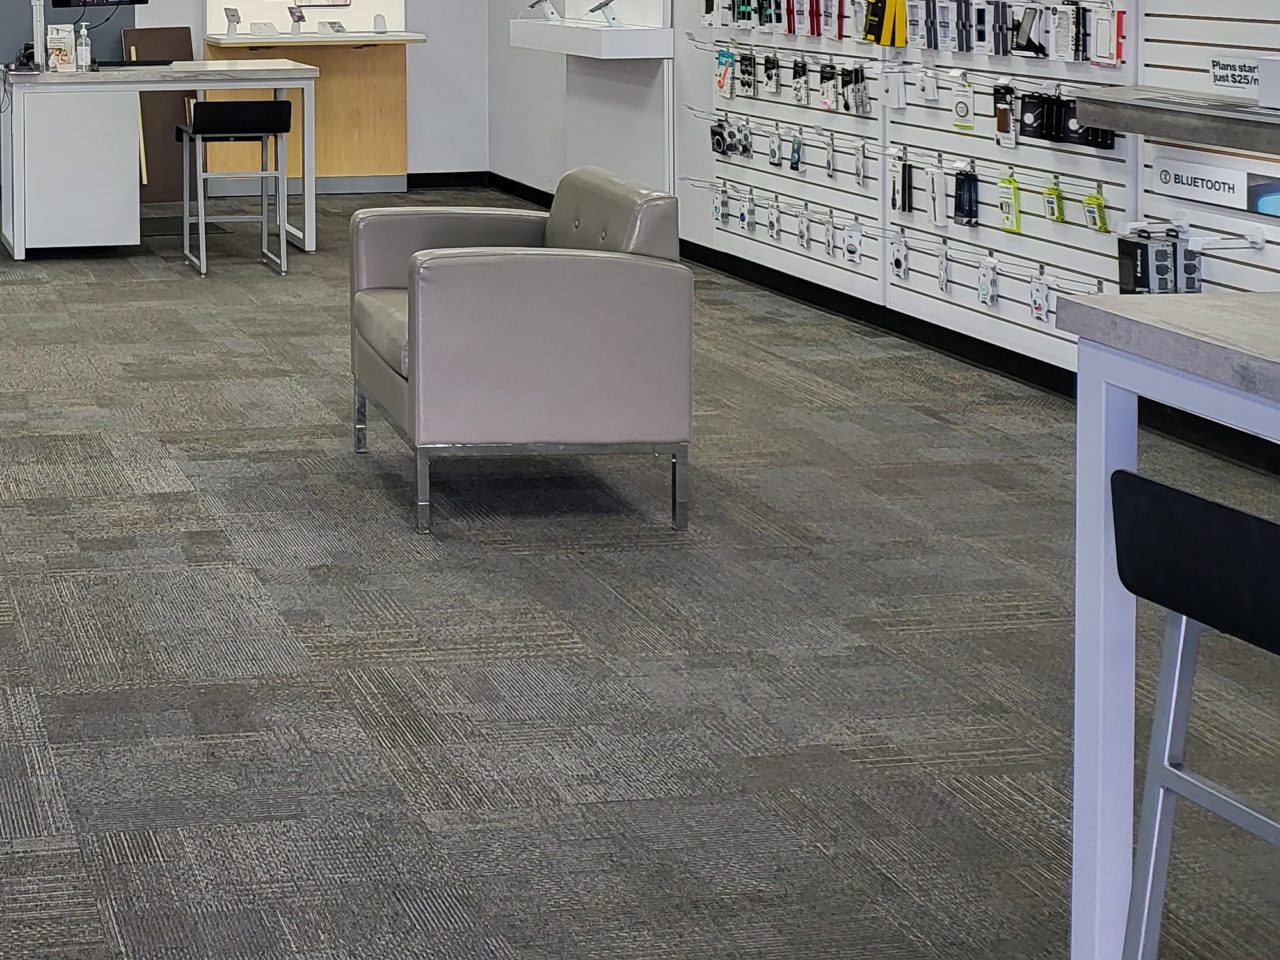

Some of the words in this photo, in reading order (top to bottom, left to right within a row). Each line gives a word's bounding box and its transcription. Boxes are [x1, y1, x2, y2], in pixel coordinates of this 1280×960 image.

[1212, 59, 1237, 72] Plans
[1212, 71, 1230, 84] just
[1173, 173, 1236, 194] BLUETOOTH
